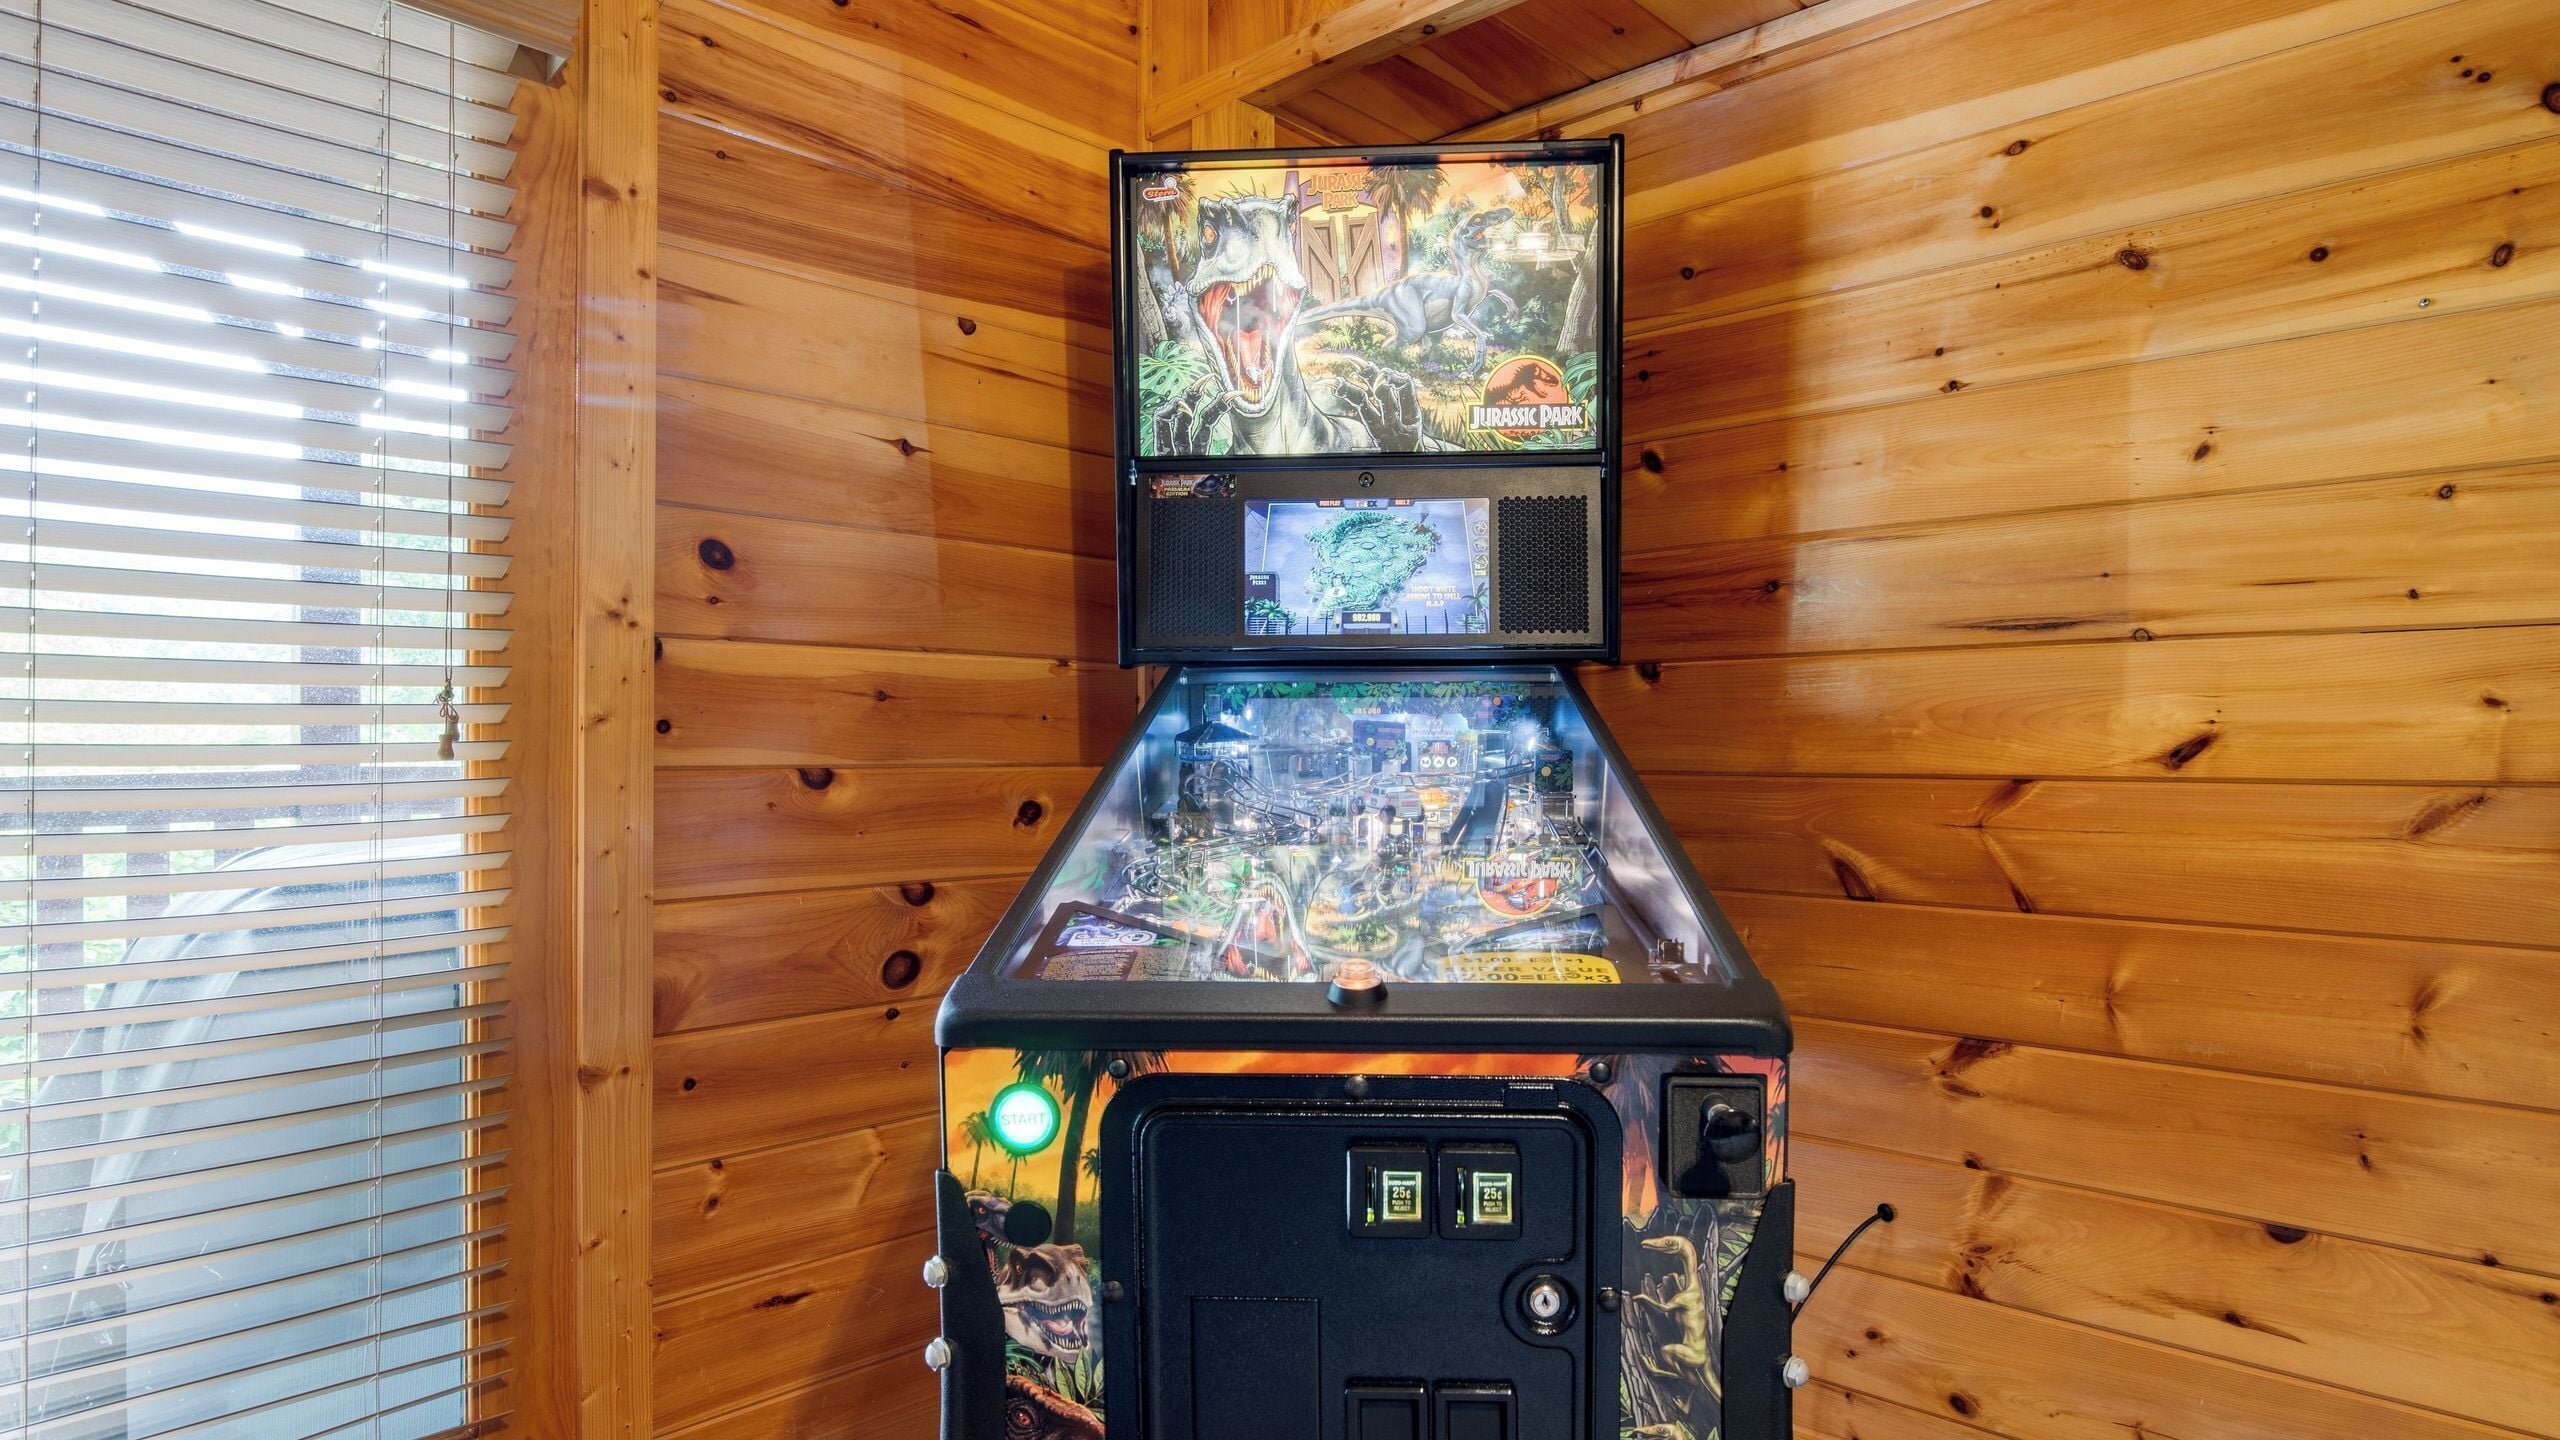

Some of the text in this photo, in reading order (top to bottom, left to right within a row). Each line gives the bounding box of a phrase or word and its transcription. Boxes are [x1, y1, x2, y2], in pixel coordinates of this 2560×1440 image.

[1322, 191, 1359, 211] PARK
[1470, 404, 1584, 430] JURASSIC PARK
[1001, 1112, 1046, 1126] START
[1392, 1186, 1411, 1199] 25¢
[1483, 1187, 1502, 1200] 25¢
